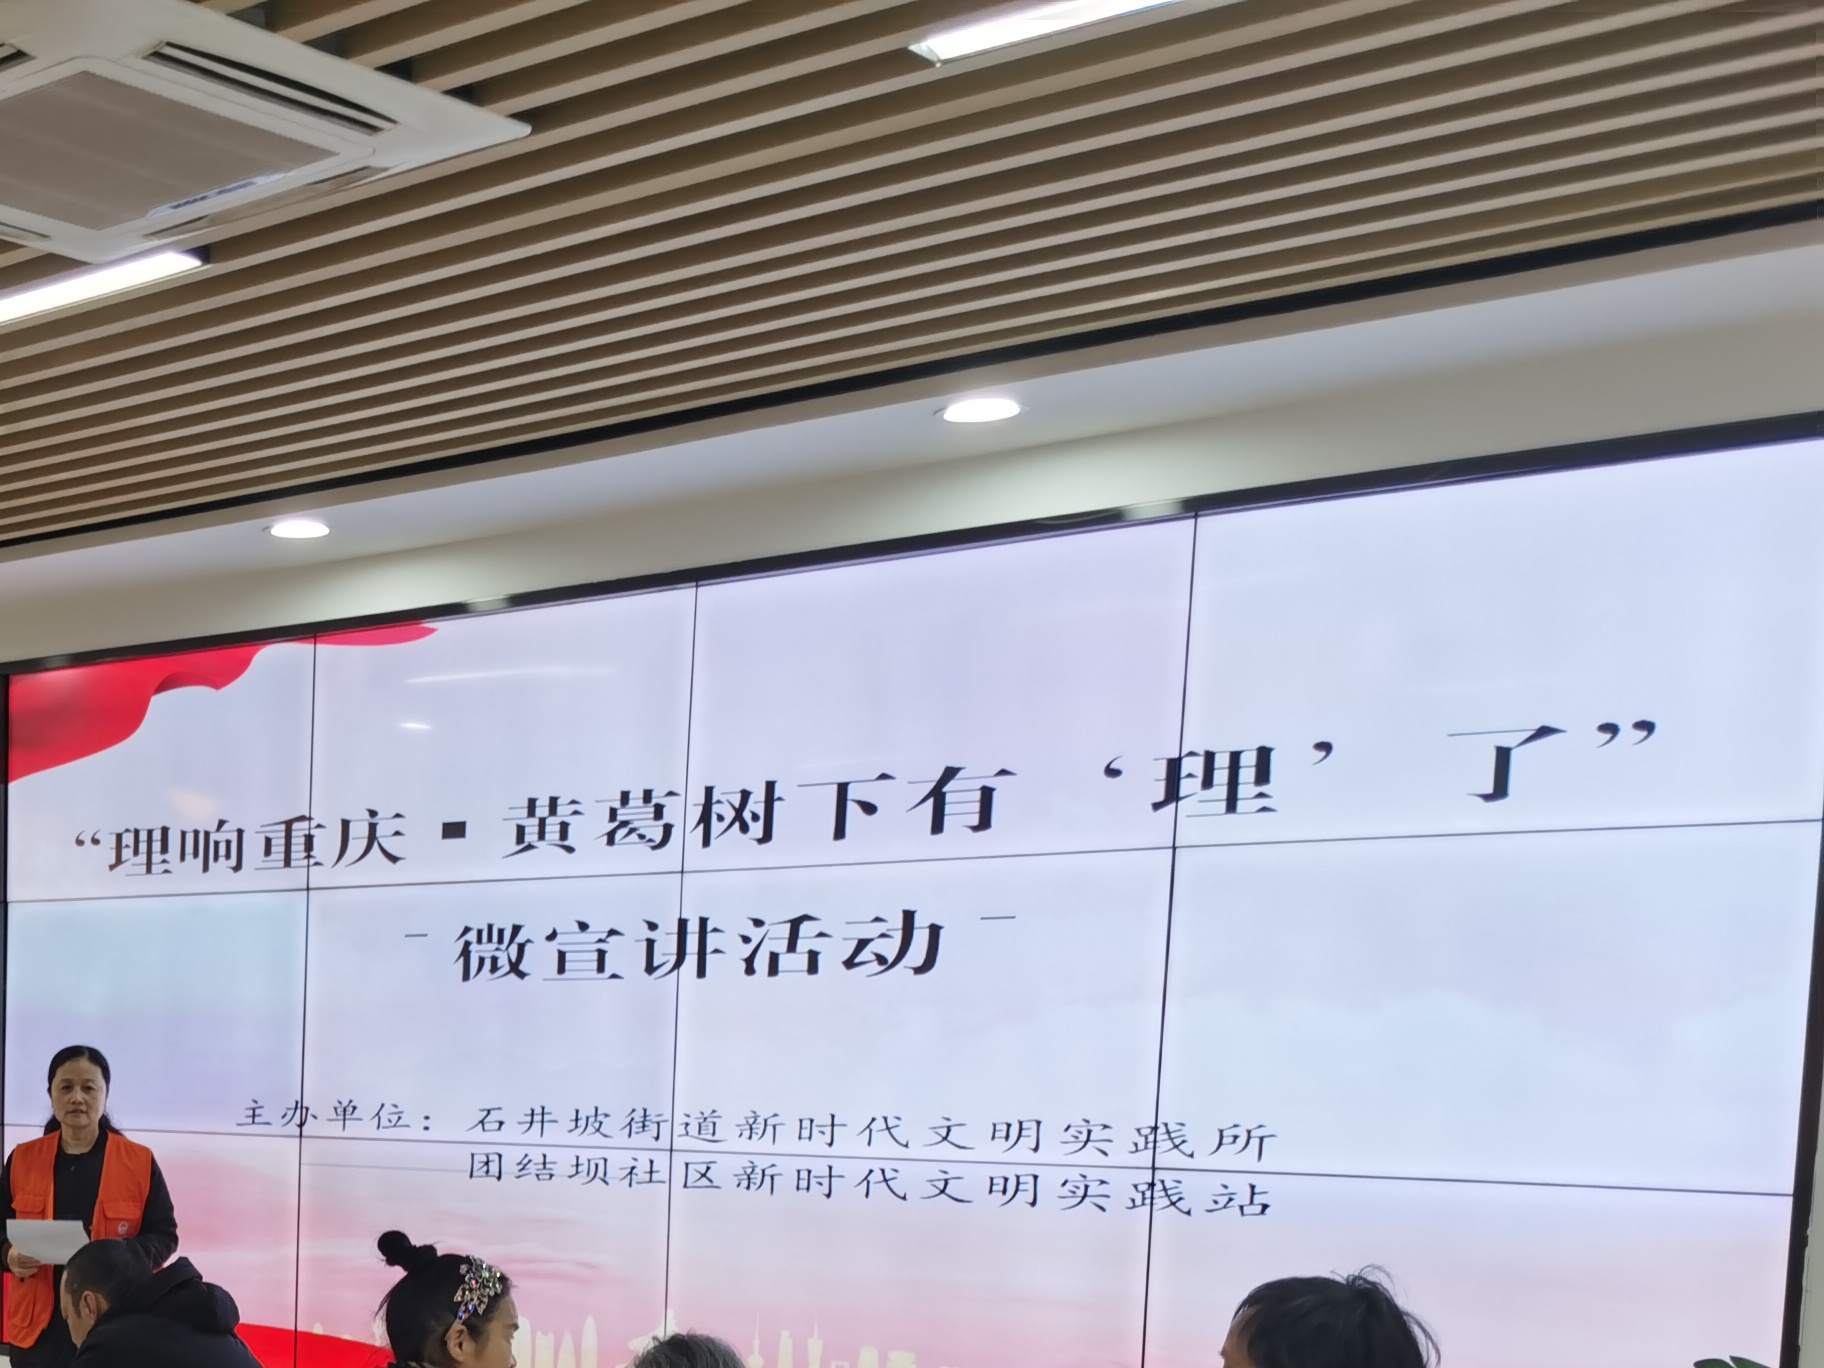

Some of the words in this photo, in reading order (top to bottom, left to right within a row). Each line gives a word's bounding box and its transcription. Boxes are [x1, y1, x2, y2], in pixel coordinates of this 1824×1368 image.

[468, 1151, 1272, 1219] 团结坝社区新时代文明实践站
